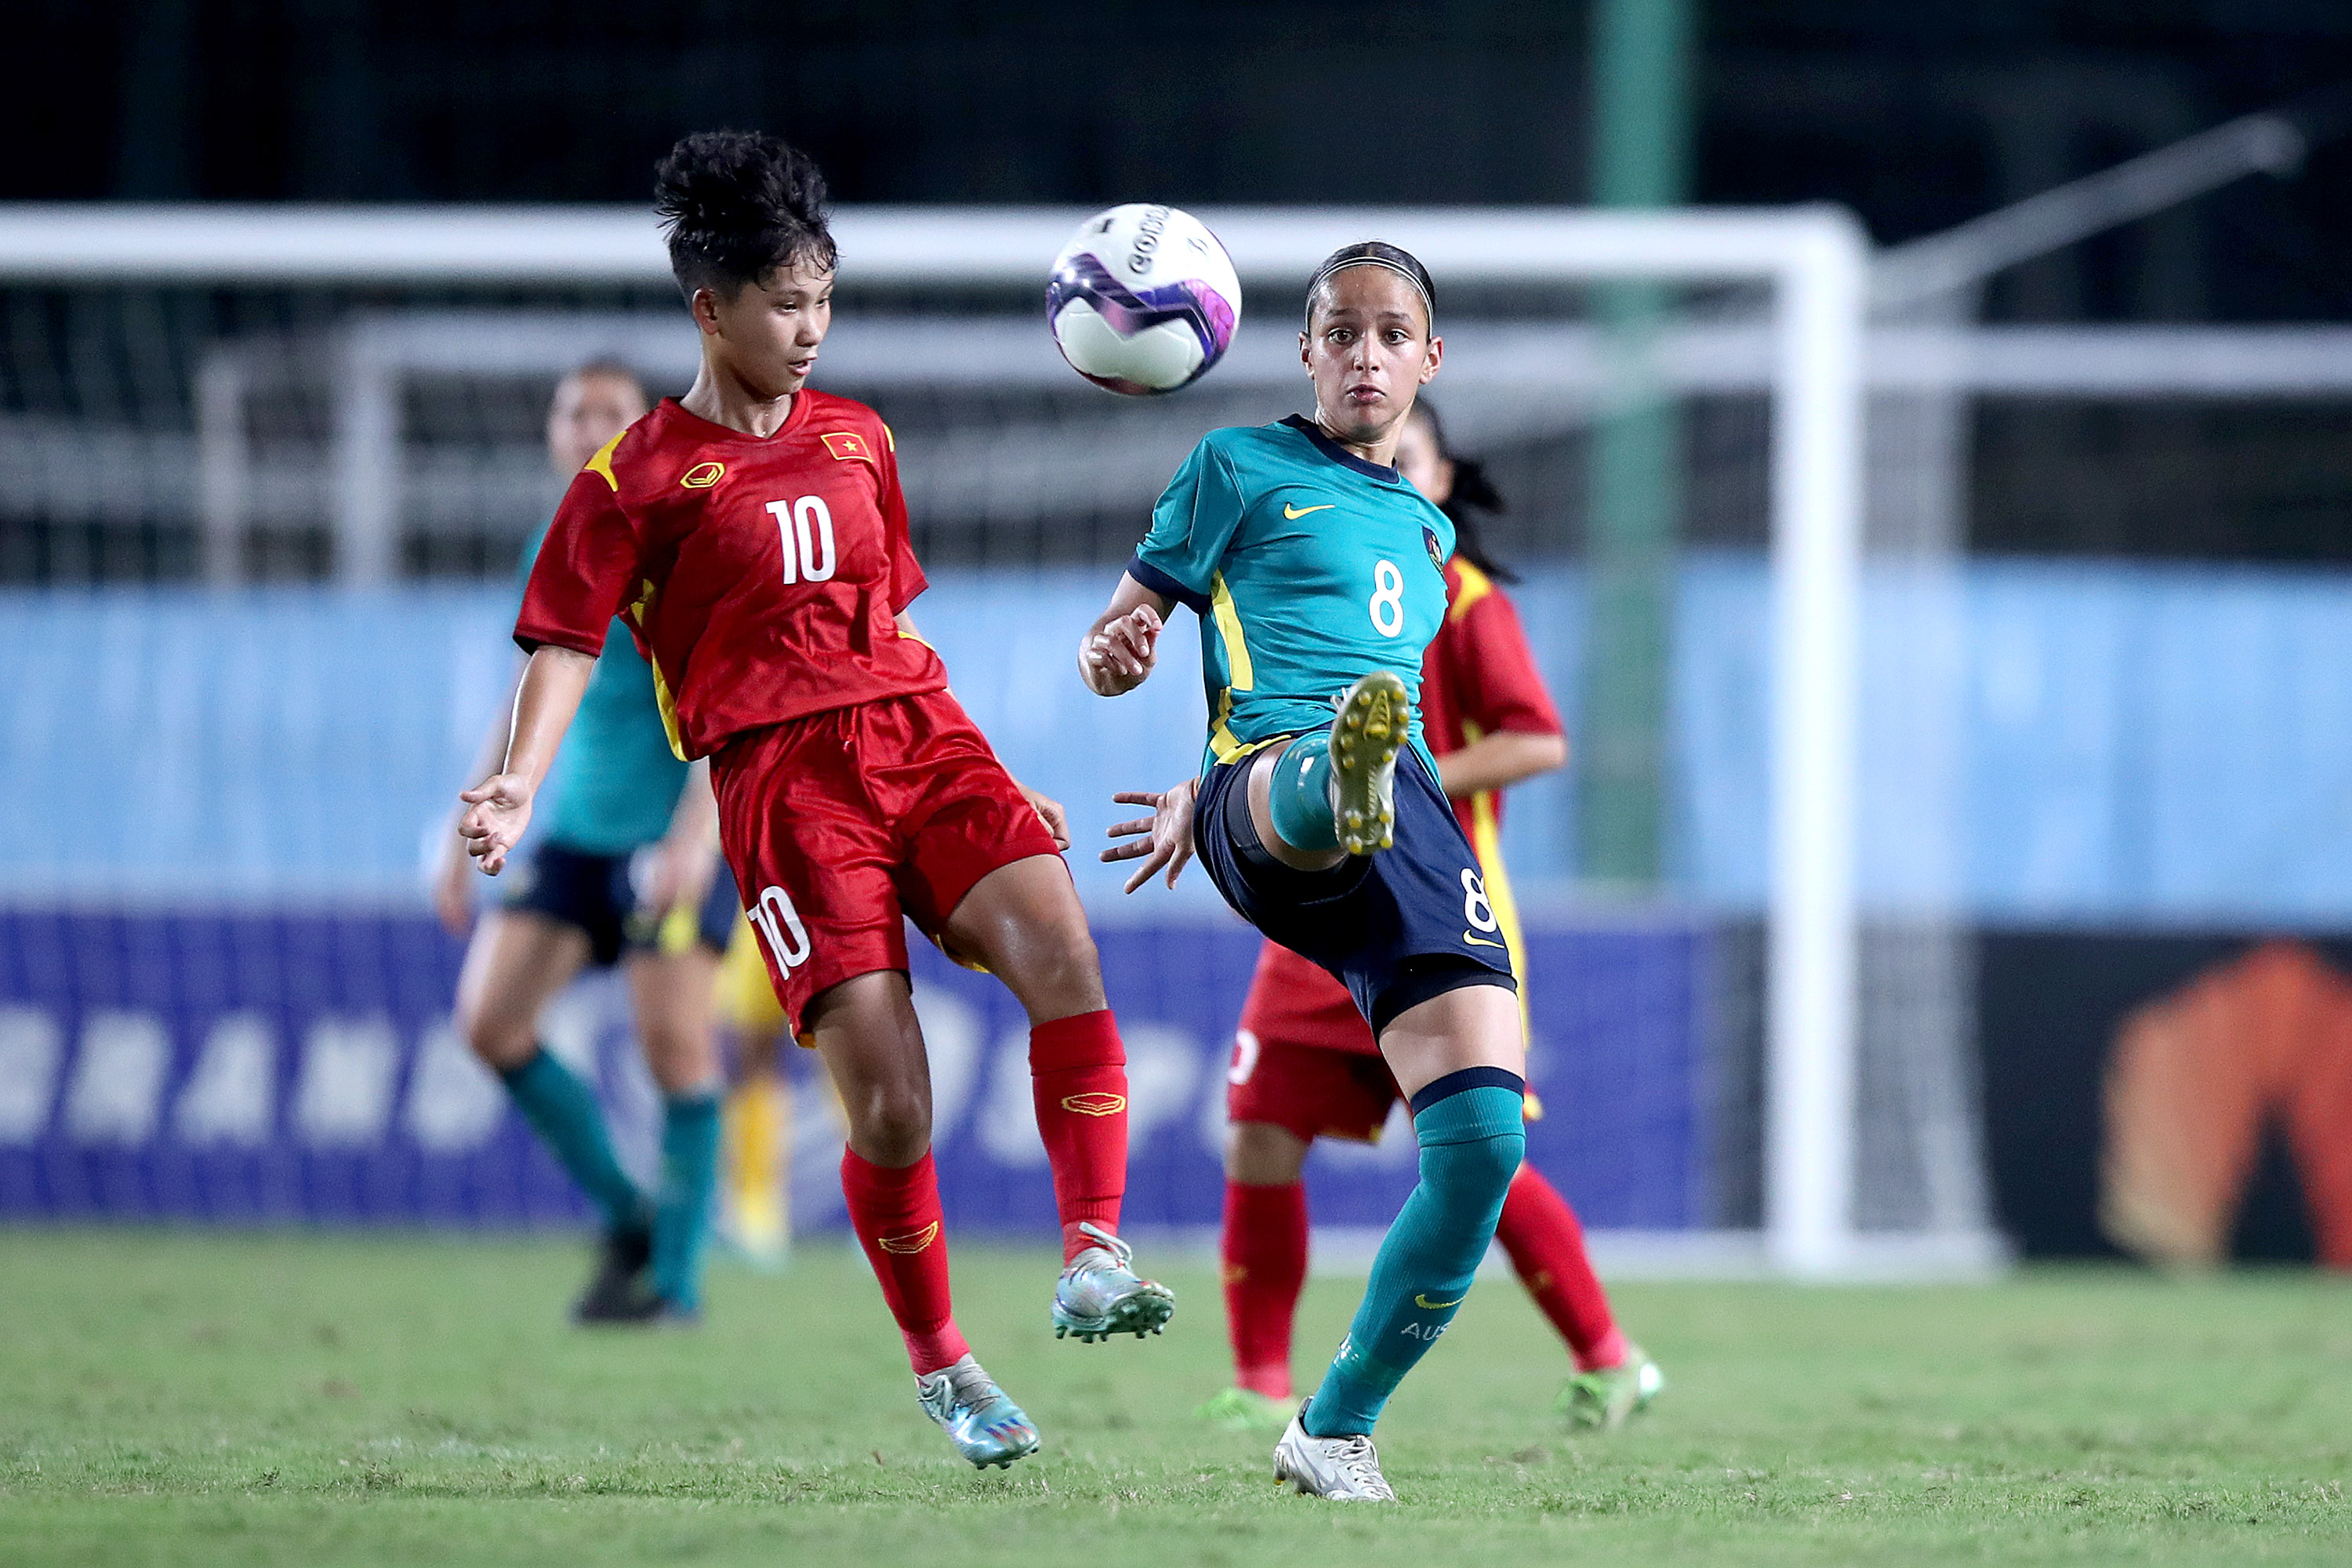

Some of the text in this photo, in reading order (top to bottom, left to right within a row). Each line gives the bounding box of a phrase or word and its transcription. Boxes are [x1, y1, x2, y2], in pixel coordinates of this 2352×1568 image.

[765, 495, 837, 584] 10
[1369, 559, 1404, 638] 8
[746, 885, 812, 981] 10
[1459, 867, 1497, 933] 8
